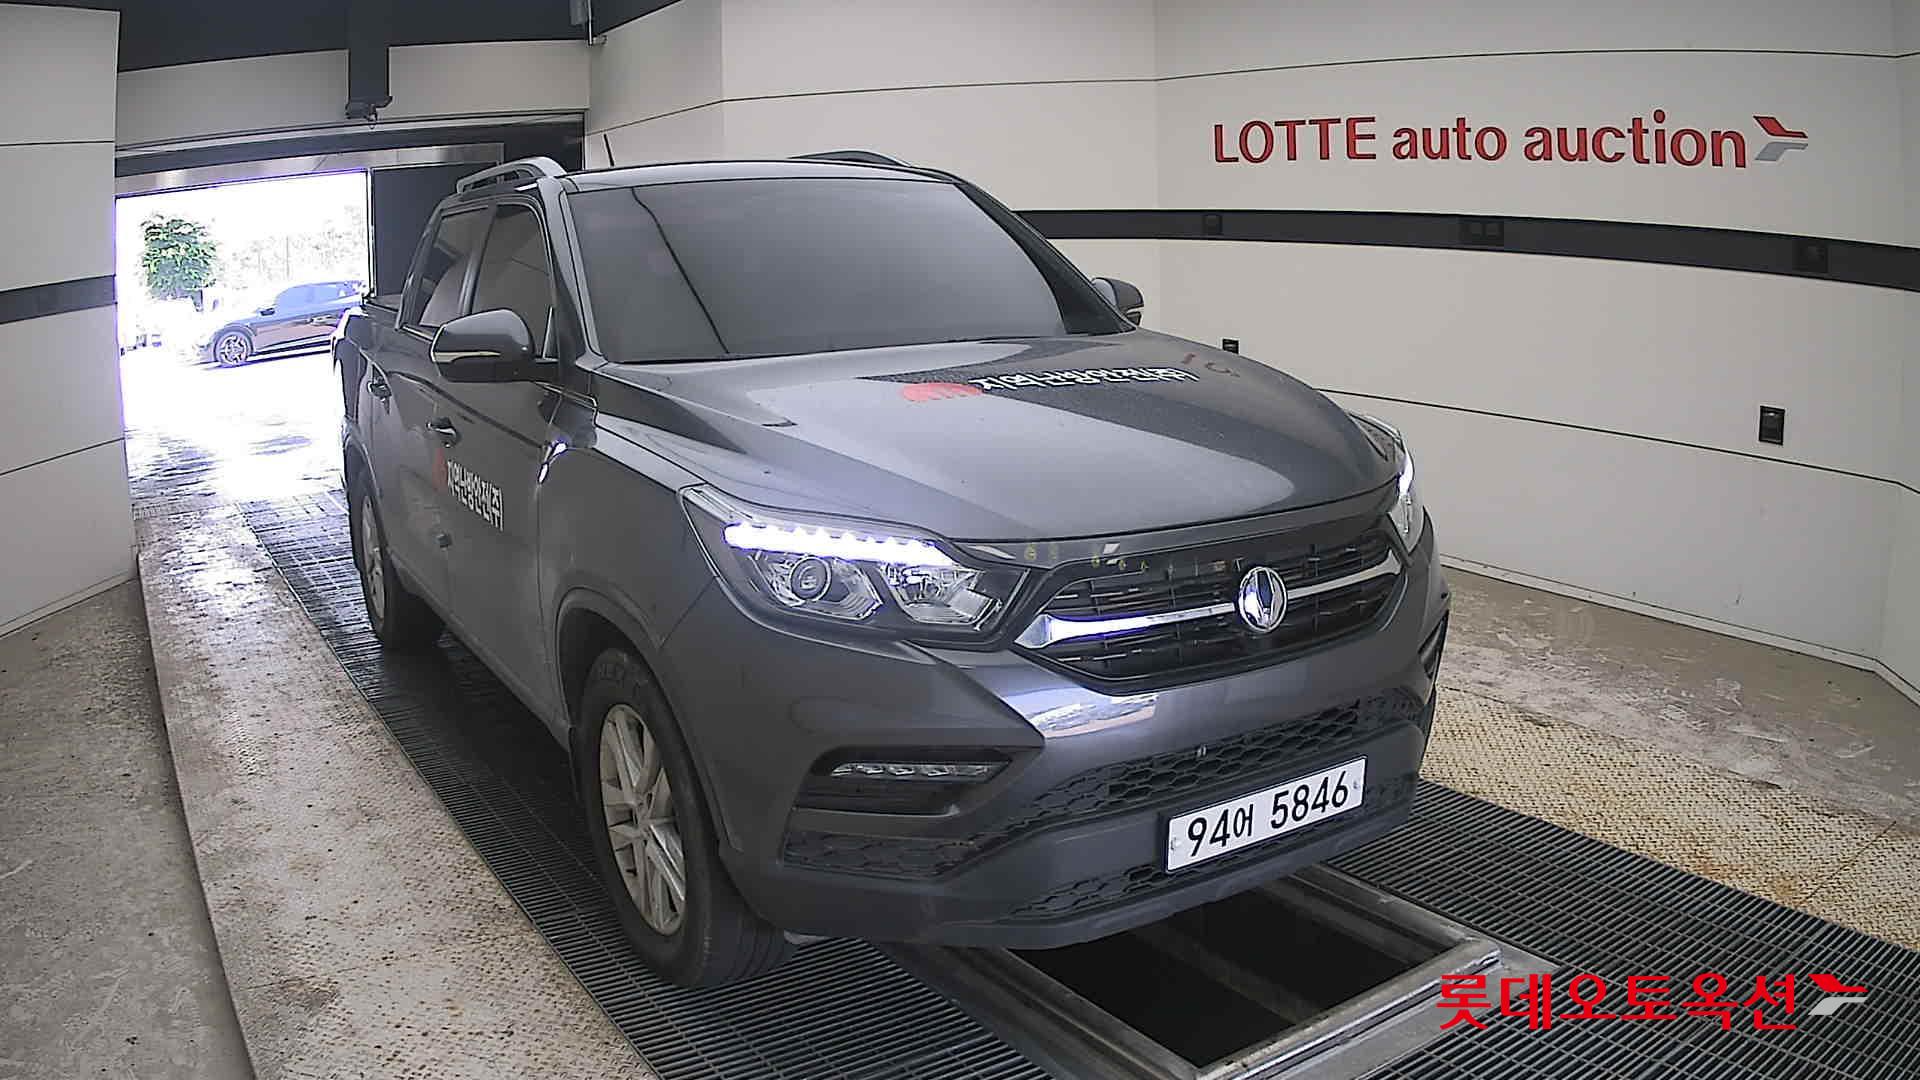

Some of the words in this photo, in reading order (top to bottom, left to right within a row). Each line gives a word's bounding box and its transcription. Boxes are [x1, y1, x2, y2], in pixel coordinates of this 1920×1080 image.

[1213, 116, 1377, 164] LOTTE
[1393, 117, 1507, 163] auto
[1524, 109, 1747, 168] auction
[1187, 803, 1254, 857] 94어
[1270, 770, 1349, 829] 5846
